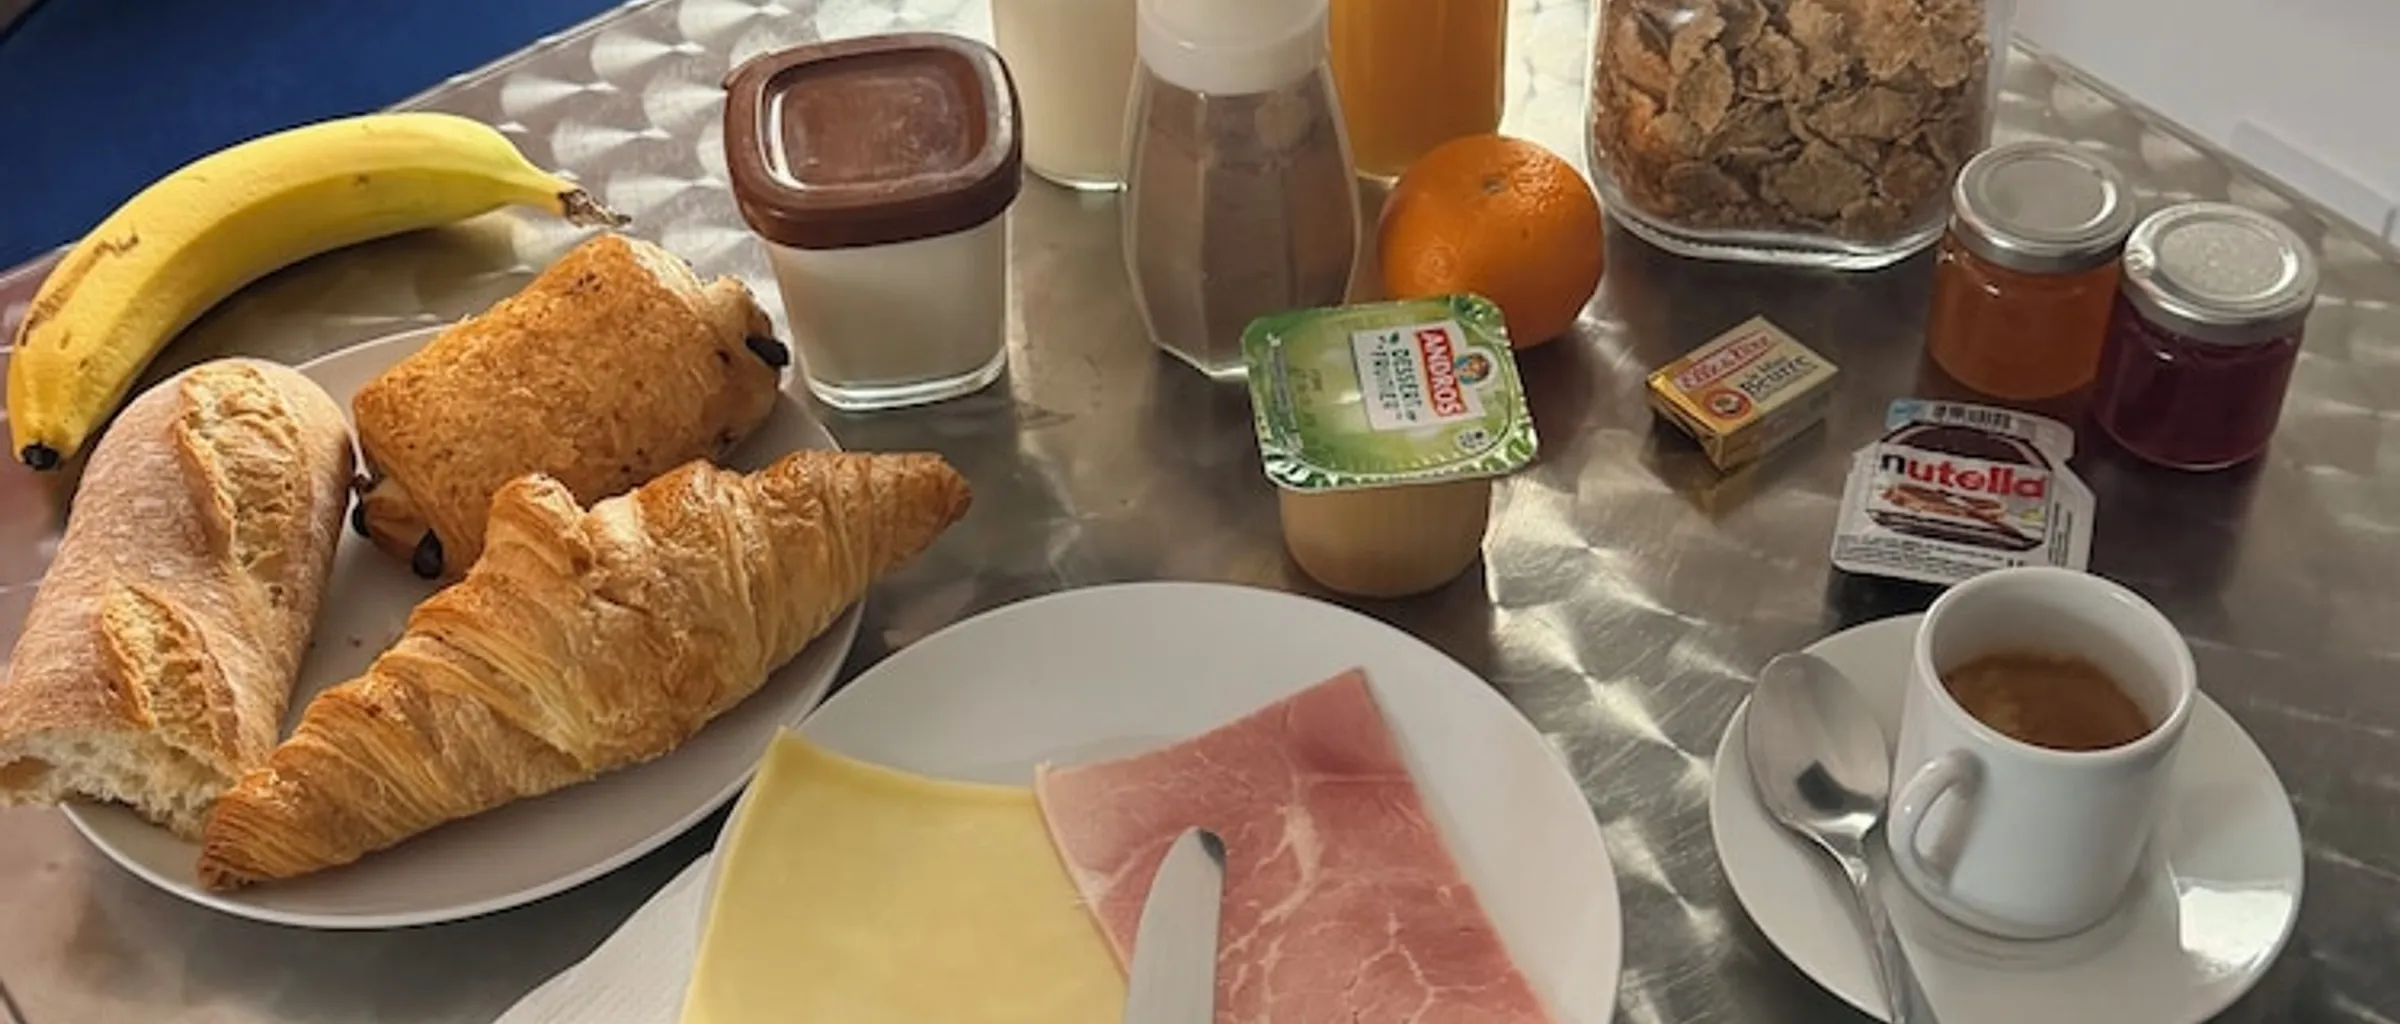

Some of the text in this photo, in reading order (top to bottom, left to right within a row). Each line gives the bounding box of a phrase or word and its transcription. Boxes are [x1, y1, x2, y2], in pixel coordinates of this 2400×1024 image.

[1392, 348, 1422, 408] DESSERT
[1420, 333, 1462, 415] ANDROS
[1881, 454, 2047, 499] nutella
